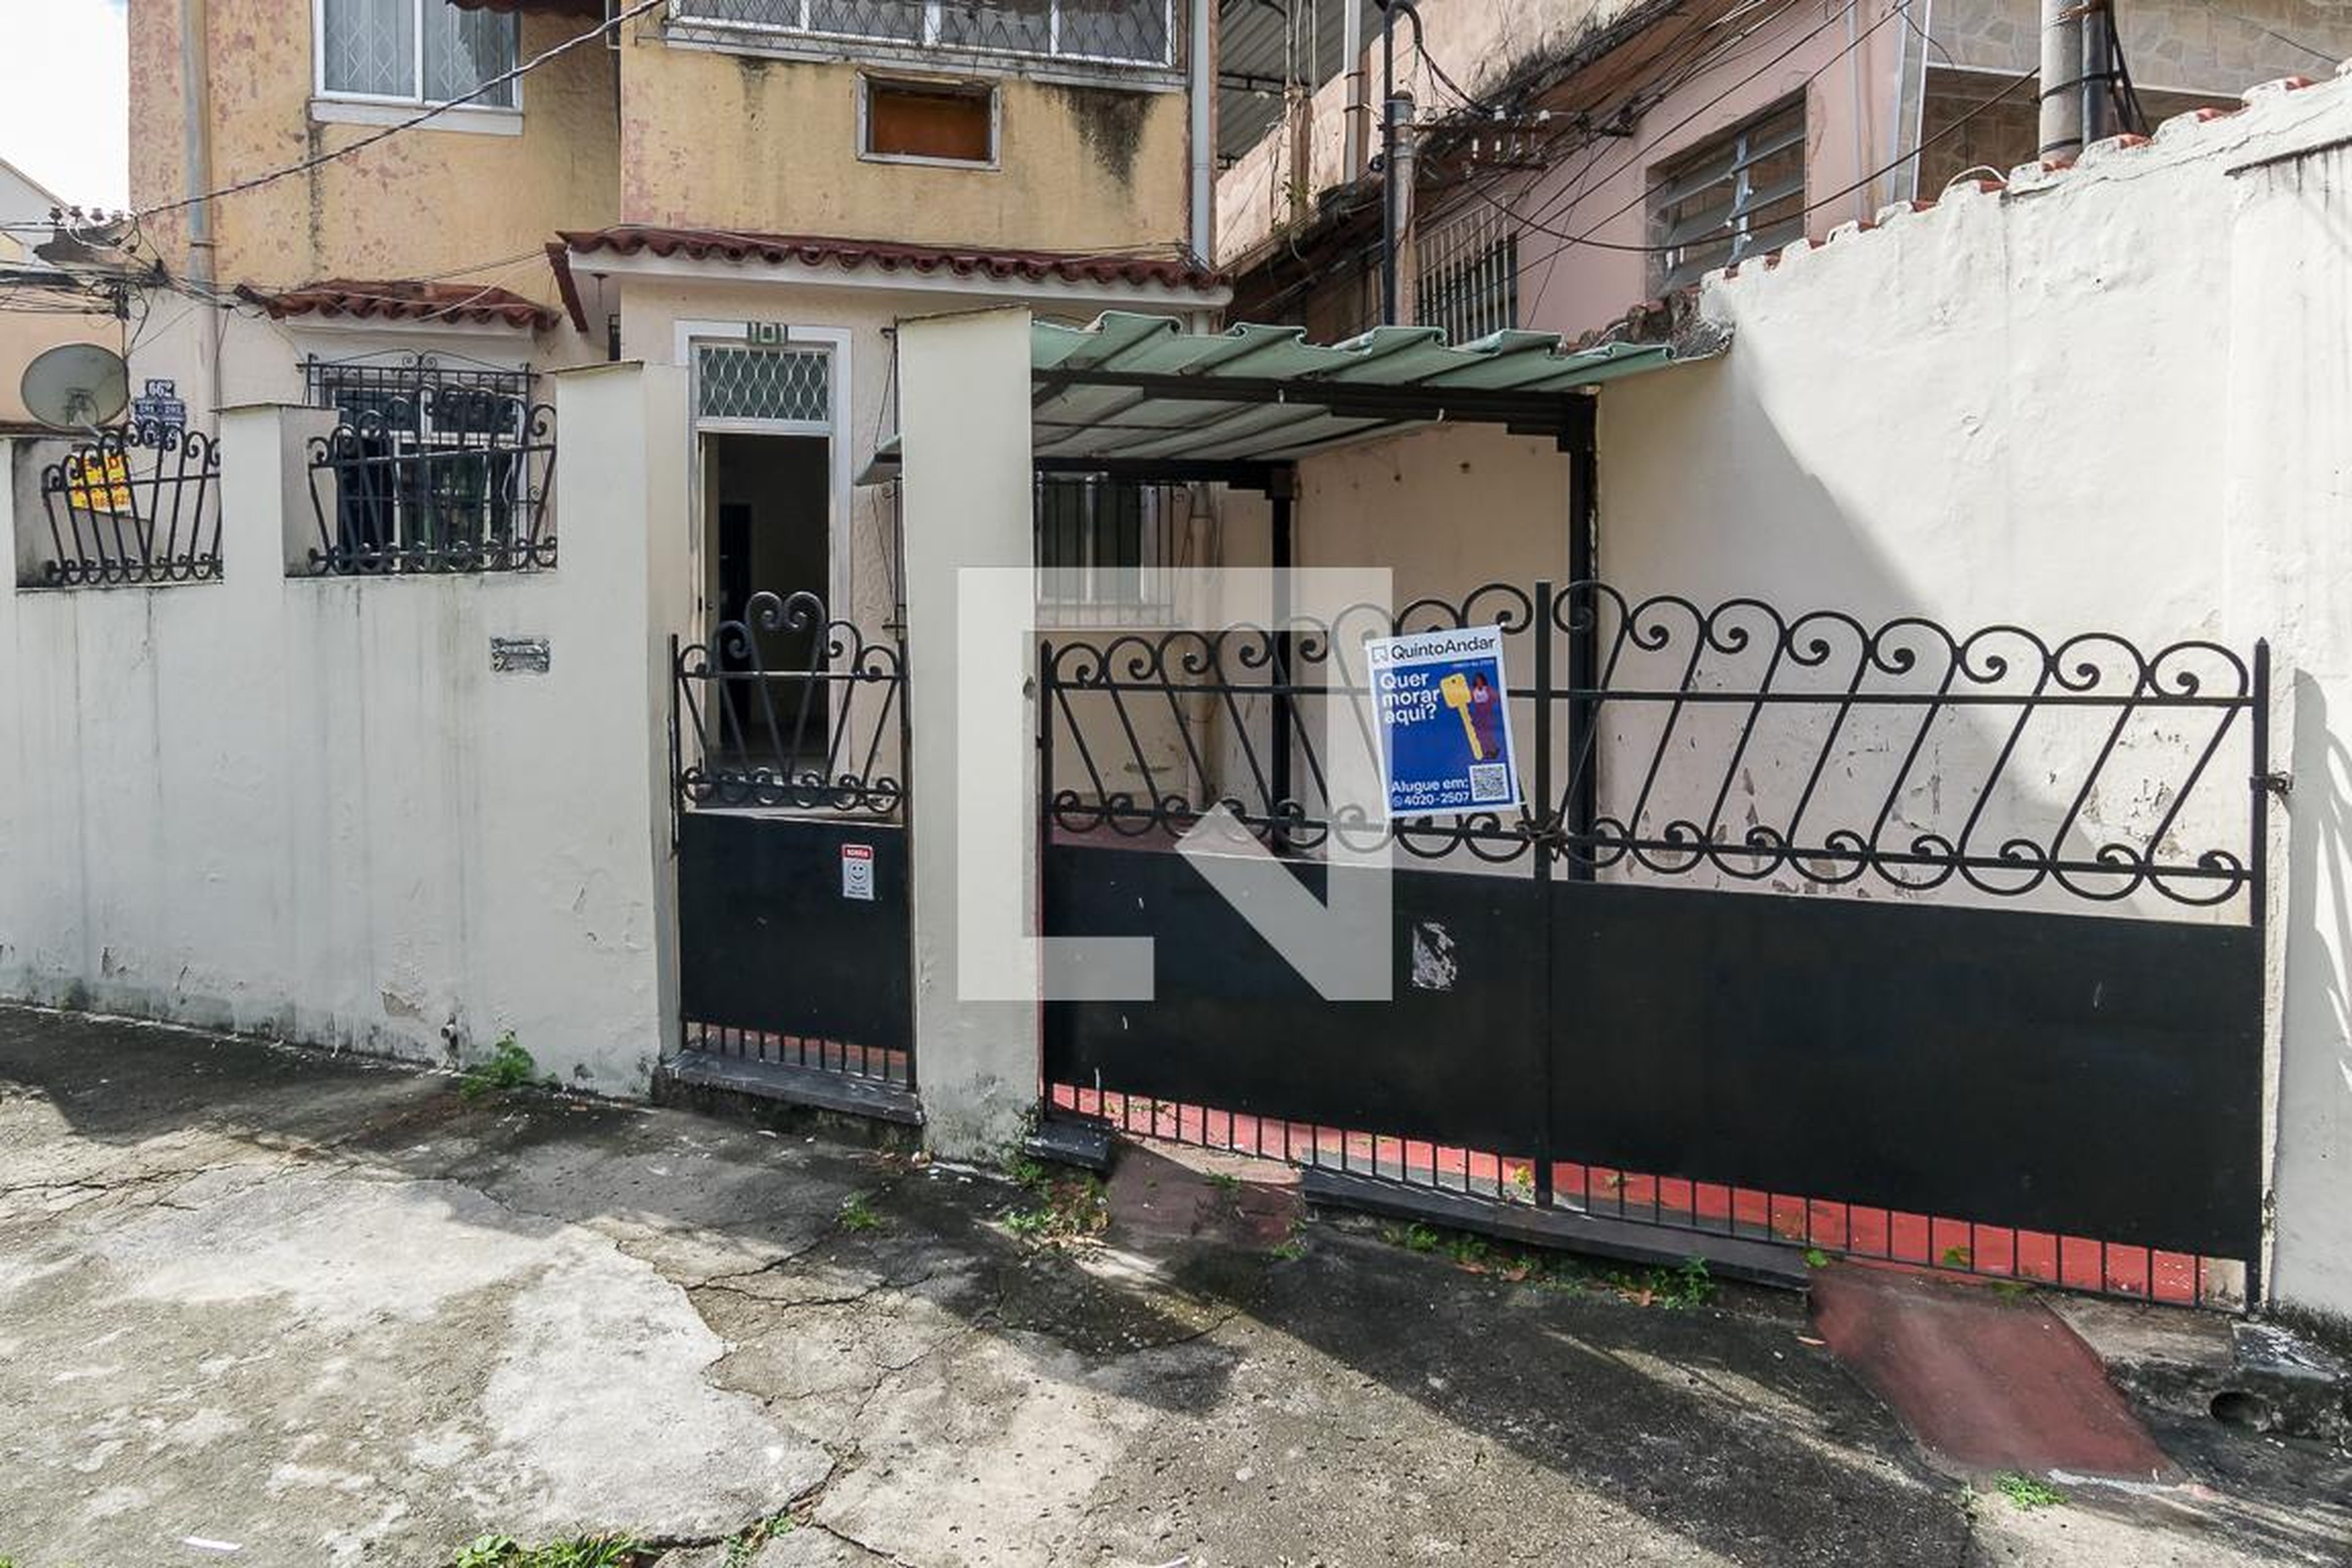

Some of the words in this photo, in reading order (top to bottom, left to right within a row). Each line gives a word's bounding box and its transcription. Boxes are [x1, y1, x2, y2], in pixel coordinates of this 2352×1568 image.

[148, 381, 172, 397] 662
[1391, 636, 1495, 660] QuintoAndar
[1380, 673, 1430, 688] Quer
[1382, 689, 1440, 707] morar
[1385, 703, 1436, 726] aqui?
[1391, 781, 1440, 795] Alugue
[1442, 777, 1469, 789] em:
[1404, 791, 1469, 805] 4020-2507
